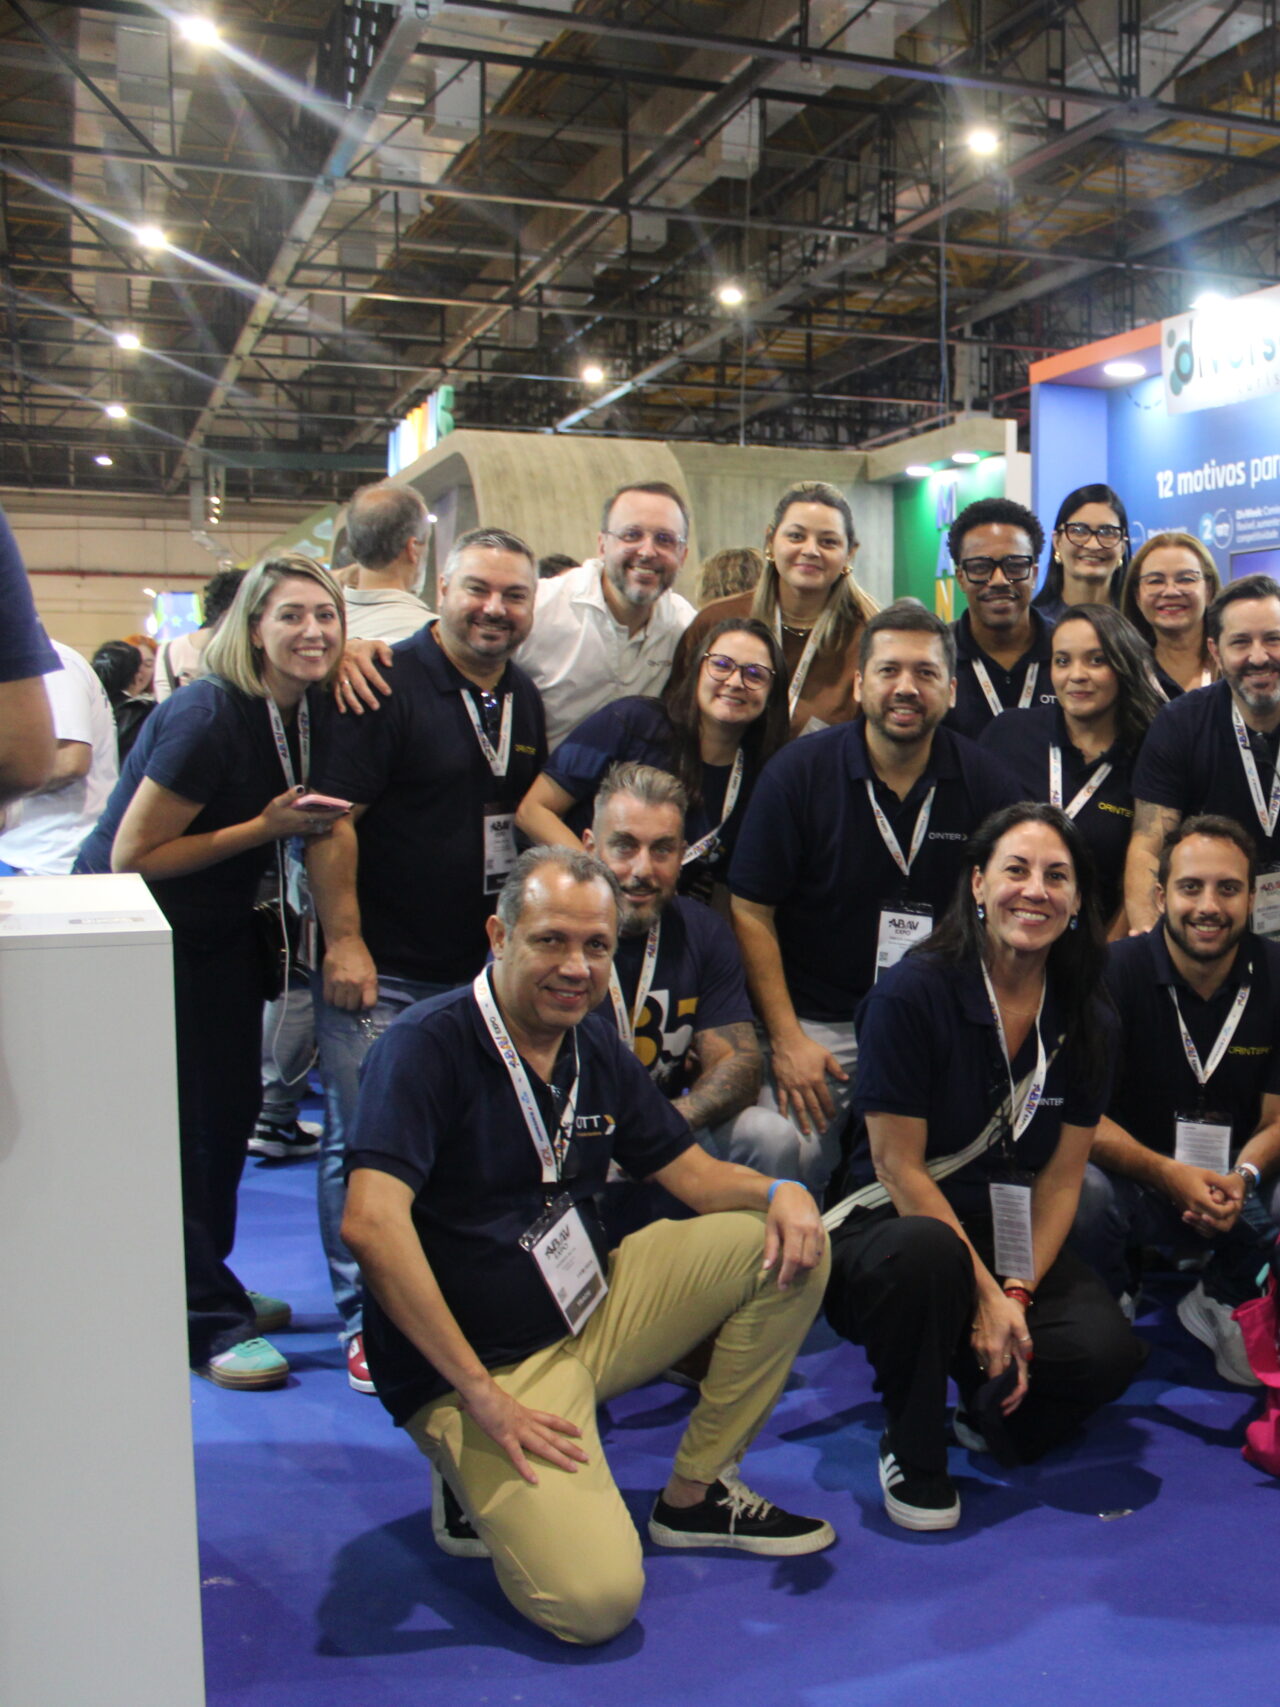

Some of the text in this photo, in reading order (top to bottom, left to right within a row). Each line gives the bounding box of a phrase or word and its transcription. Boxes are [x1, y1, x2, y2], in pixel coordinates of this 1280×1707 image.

[1156, 470, 1175, 500] 12
[1176, 465, 1247, 496] motivos
[1202, 518, 1213, 541] 2
[575, 1115, 601, 1129] OTT
